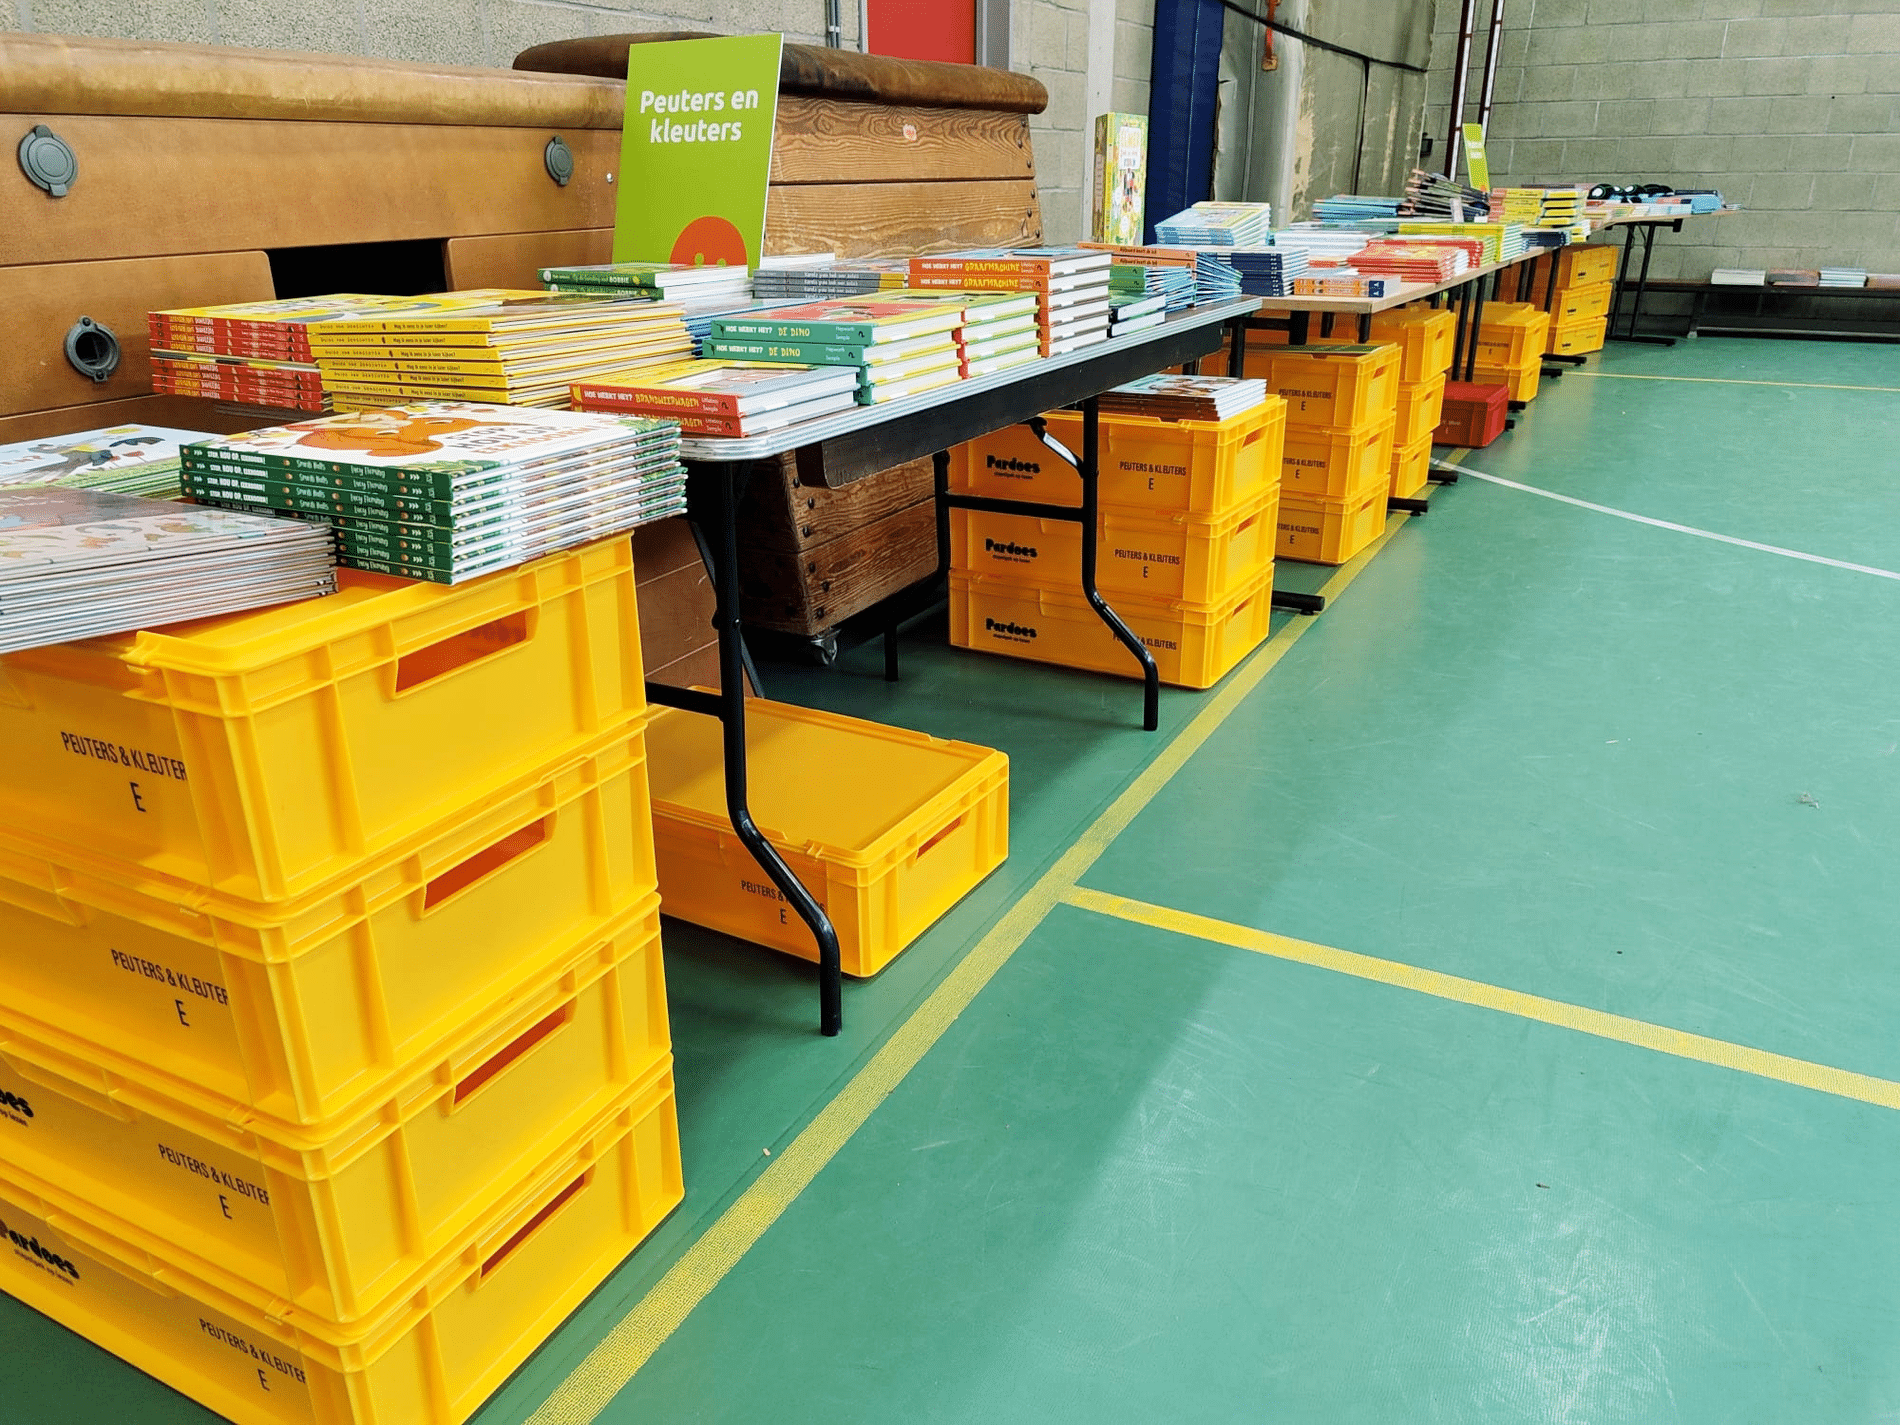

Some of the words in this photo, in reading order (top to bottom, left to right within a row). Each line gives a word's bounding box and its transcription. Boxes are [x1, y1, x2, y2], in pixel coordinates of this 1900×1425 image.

[640, 89, 725, 114] Peuters
[731, 89, 759, 110] en
[650, 118, 742, 143] kleuters
[738, 326, 757, 334] WERKT
[790, 328, 810, 337] DINO
[716, 344, 728, 352] HOE
[729, 345, 748, 353] WERKT
[748, 346, 764, 354] HET?
[781, 348, 800, 357] DINO
[584, 390, 598, 399] HOE
[598, 391, 616, 400] WERKT
[618, 392, 632, 401] HET?
[635, 394, 700, 408] BRANDWEERWAGEN
[1300, 401, 1306, 411] E
[986, 455, 1040, 474] Pardoes
[1119, 461, 1147, 472] PEUTERS
[1148, 464, 1154, 472] &
[1155, 464, 1186, 476] KLEUTERS
[1148, 478, 1154, 490] E
[986, 538, 1038, 558] Pardoes
[1114, 549, 1142, 561] PEUTERS
[1143, 552, 1148, 561] &
[1149, 552, 1180, 565] KLEUTERS
[1143, 566, 1148, 578] E
[986, 618, 1037, 638] Pardoes
[1146, 638, 1177, 650] KLEUTERS
[61, 731, 118, 764] PEUTERS
[119, 746, 131, 767] &
[130, 781, 146, 812] E
[741, 880, 776, 900] PEUTERS
[780, 908, 787, 924] E
[110, 949, 165, 983] PEUTERS
[166, 968, 177, 986] &
[175, 999, 190, 1026] E
[158, 1144, 209, 1178] PEUTERS
[210, 1166, 220, 1183] &
[219, 1194, 232, 1220] E
[200, 1318, 249, 1354] PEUTERS
[249, 1344, 259, 1360] &
[257, 1368, 270, 1392] E
